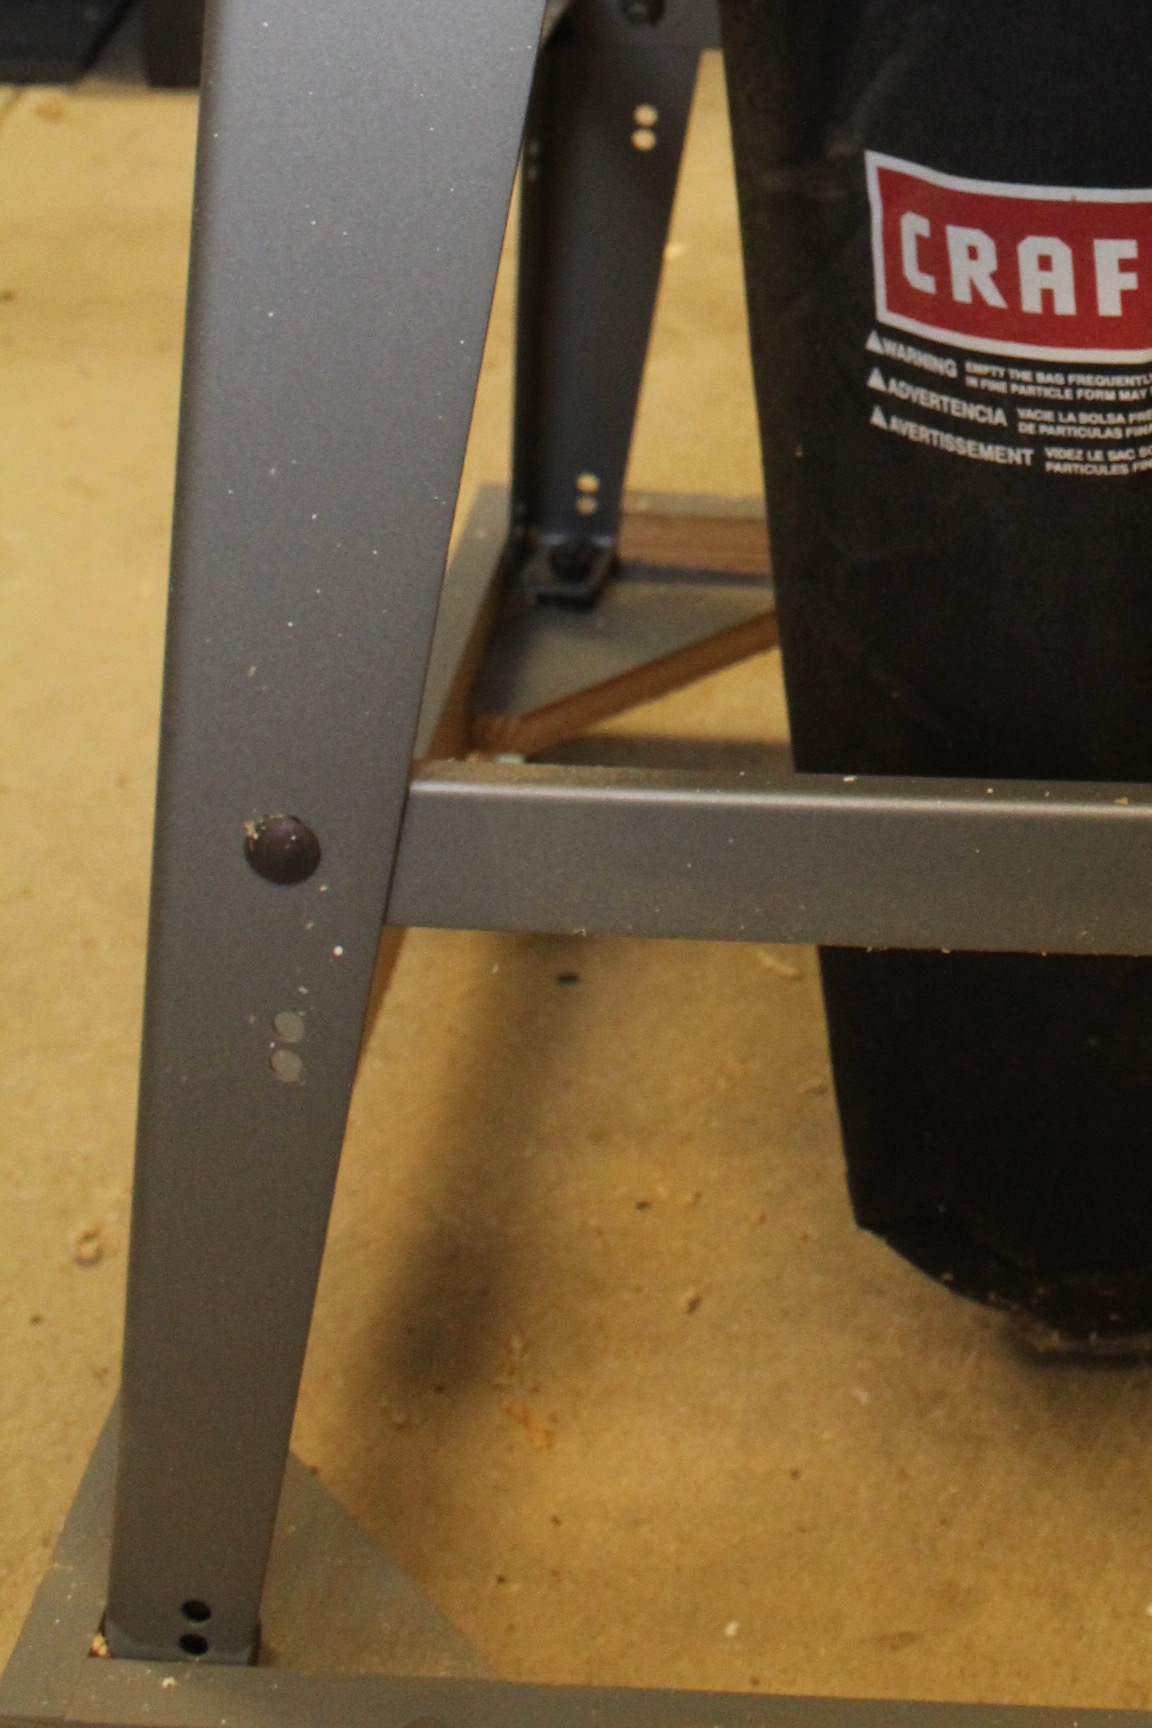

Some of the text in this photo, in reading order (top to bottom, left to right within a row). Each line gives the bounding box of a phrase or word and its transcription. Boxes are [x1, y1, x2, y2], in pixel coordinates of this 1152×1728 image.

[882, 337, 958, 379] WARNING
[965, 362, 1006, 378] EMPTY
[1008, 370, 1034, 383] THE
[1036, 372, 1065, 386] BAG
[965, 377, 979, 388] IN
[980, 380, 1008, 394] FINE
[1010, 384, 1073, 400] PARTICLE
[1075, 390, 1116, 401] FORM
[1119, 390, 1148, 401] MAY
[888, 377, 1008, 427] ADVERTENCIA
[1016, 409, 1055, 422] VACIE
[1058, 411, 1077, 423] LA
[1079, 414, 1126, 425] BOLSA
[889, 415, 1035, 466] AVERTISSEMENT
[1018, 424, 1036, 435] DE
[1038, 426, 1123, 440] PARTICULAS
[1044, 448, 1083, 462] VIDEZ
[1086, 451, 1104, 462] LE
[1107, 450, 1136, 462] SAC
[1045, 462, 1129, 476] PARTICULES
